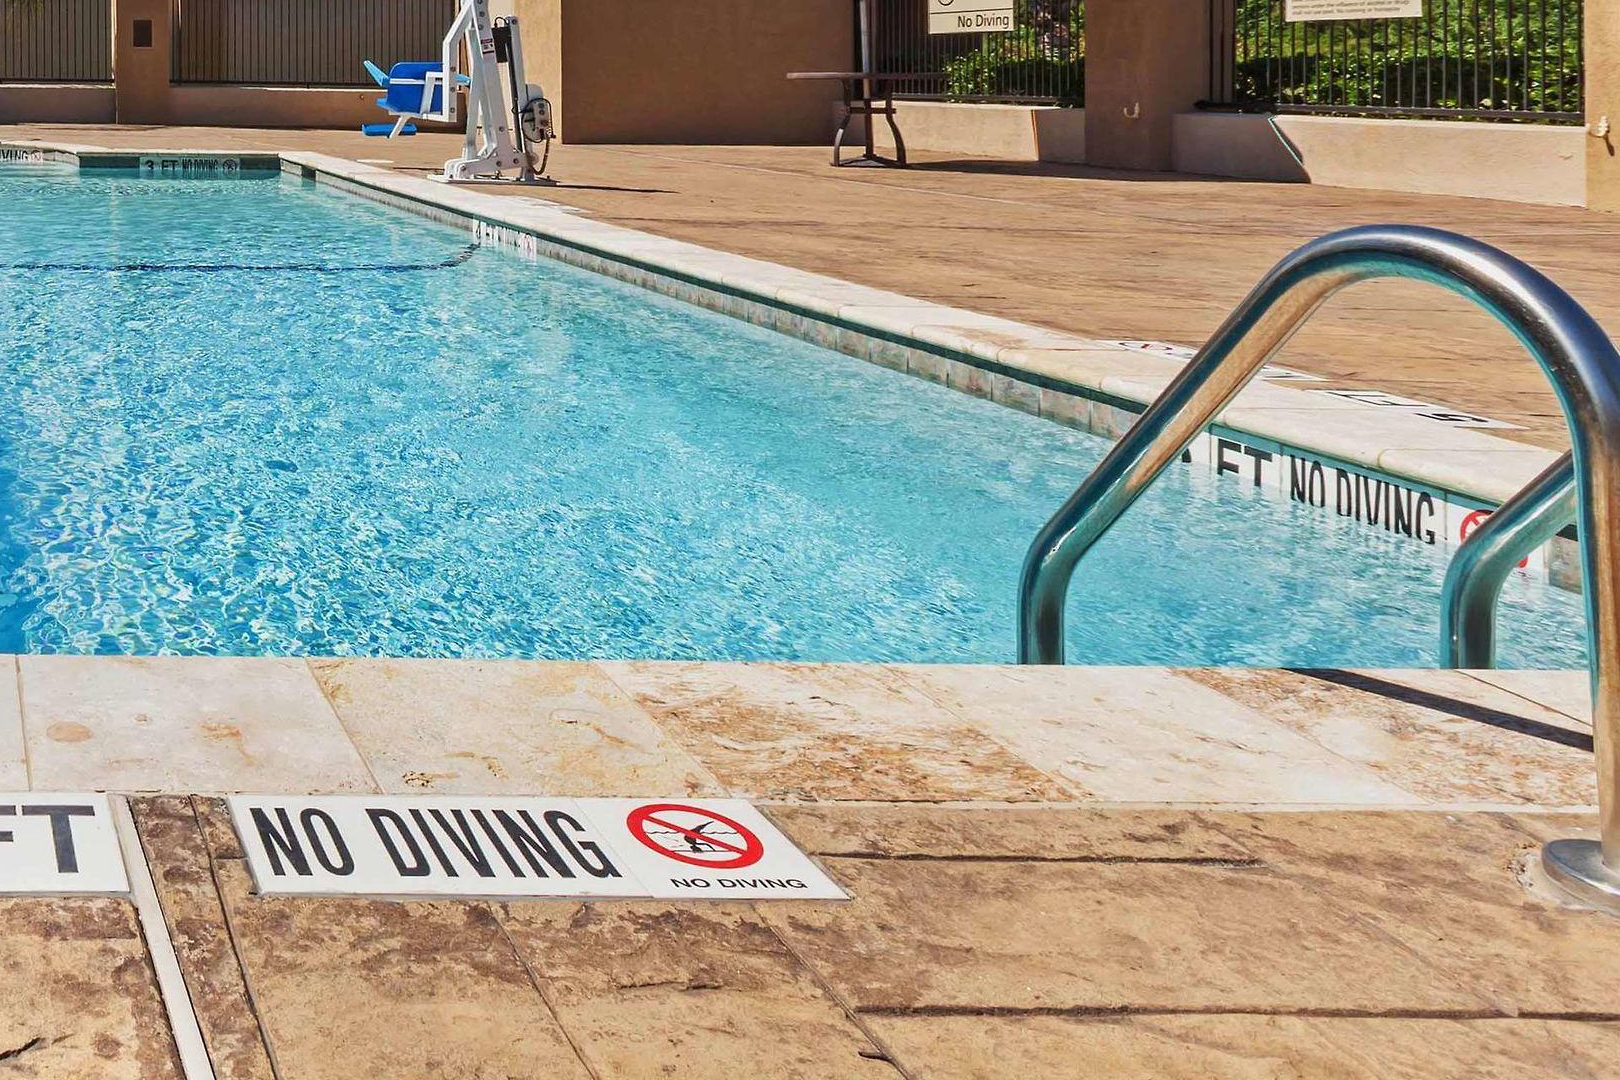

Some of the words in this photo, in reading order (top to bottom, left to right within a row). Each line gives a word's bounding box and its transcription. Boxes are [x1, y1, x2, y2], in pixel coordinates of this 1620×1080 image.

[957, 16, 972, 27] No
[976, 14, 1010, 29] Diving
[1217, 438, 1273, 487] FT
[1290, 454, 1326, 508] NO
[1336, 467, 1435, 545] DIVING
[249, 807, 355, 876] NO
[366, 807, 623, 878] DIVING
[670, 877, 713, 889] NO
[717, 877, 809, 890] DIVING
